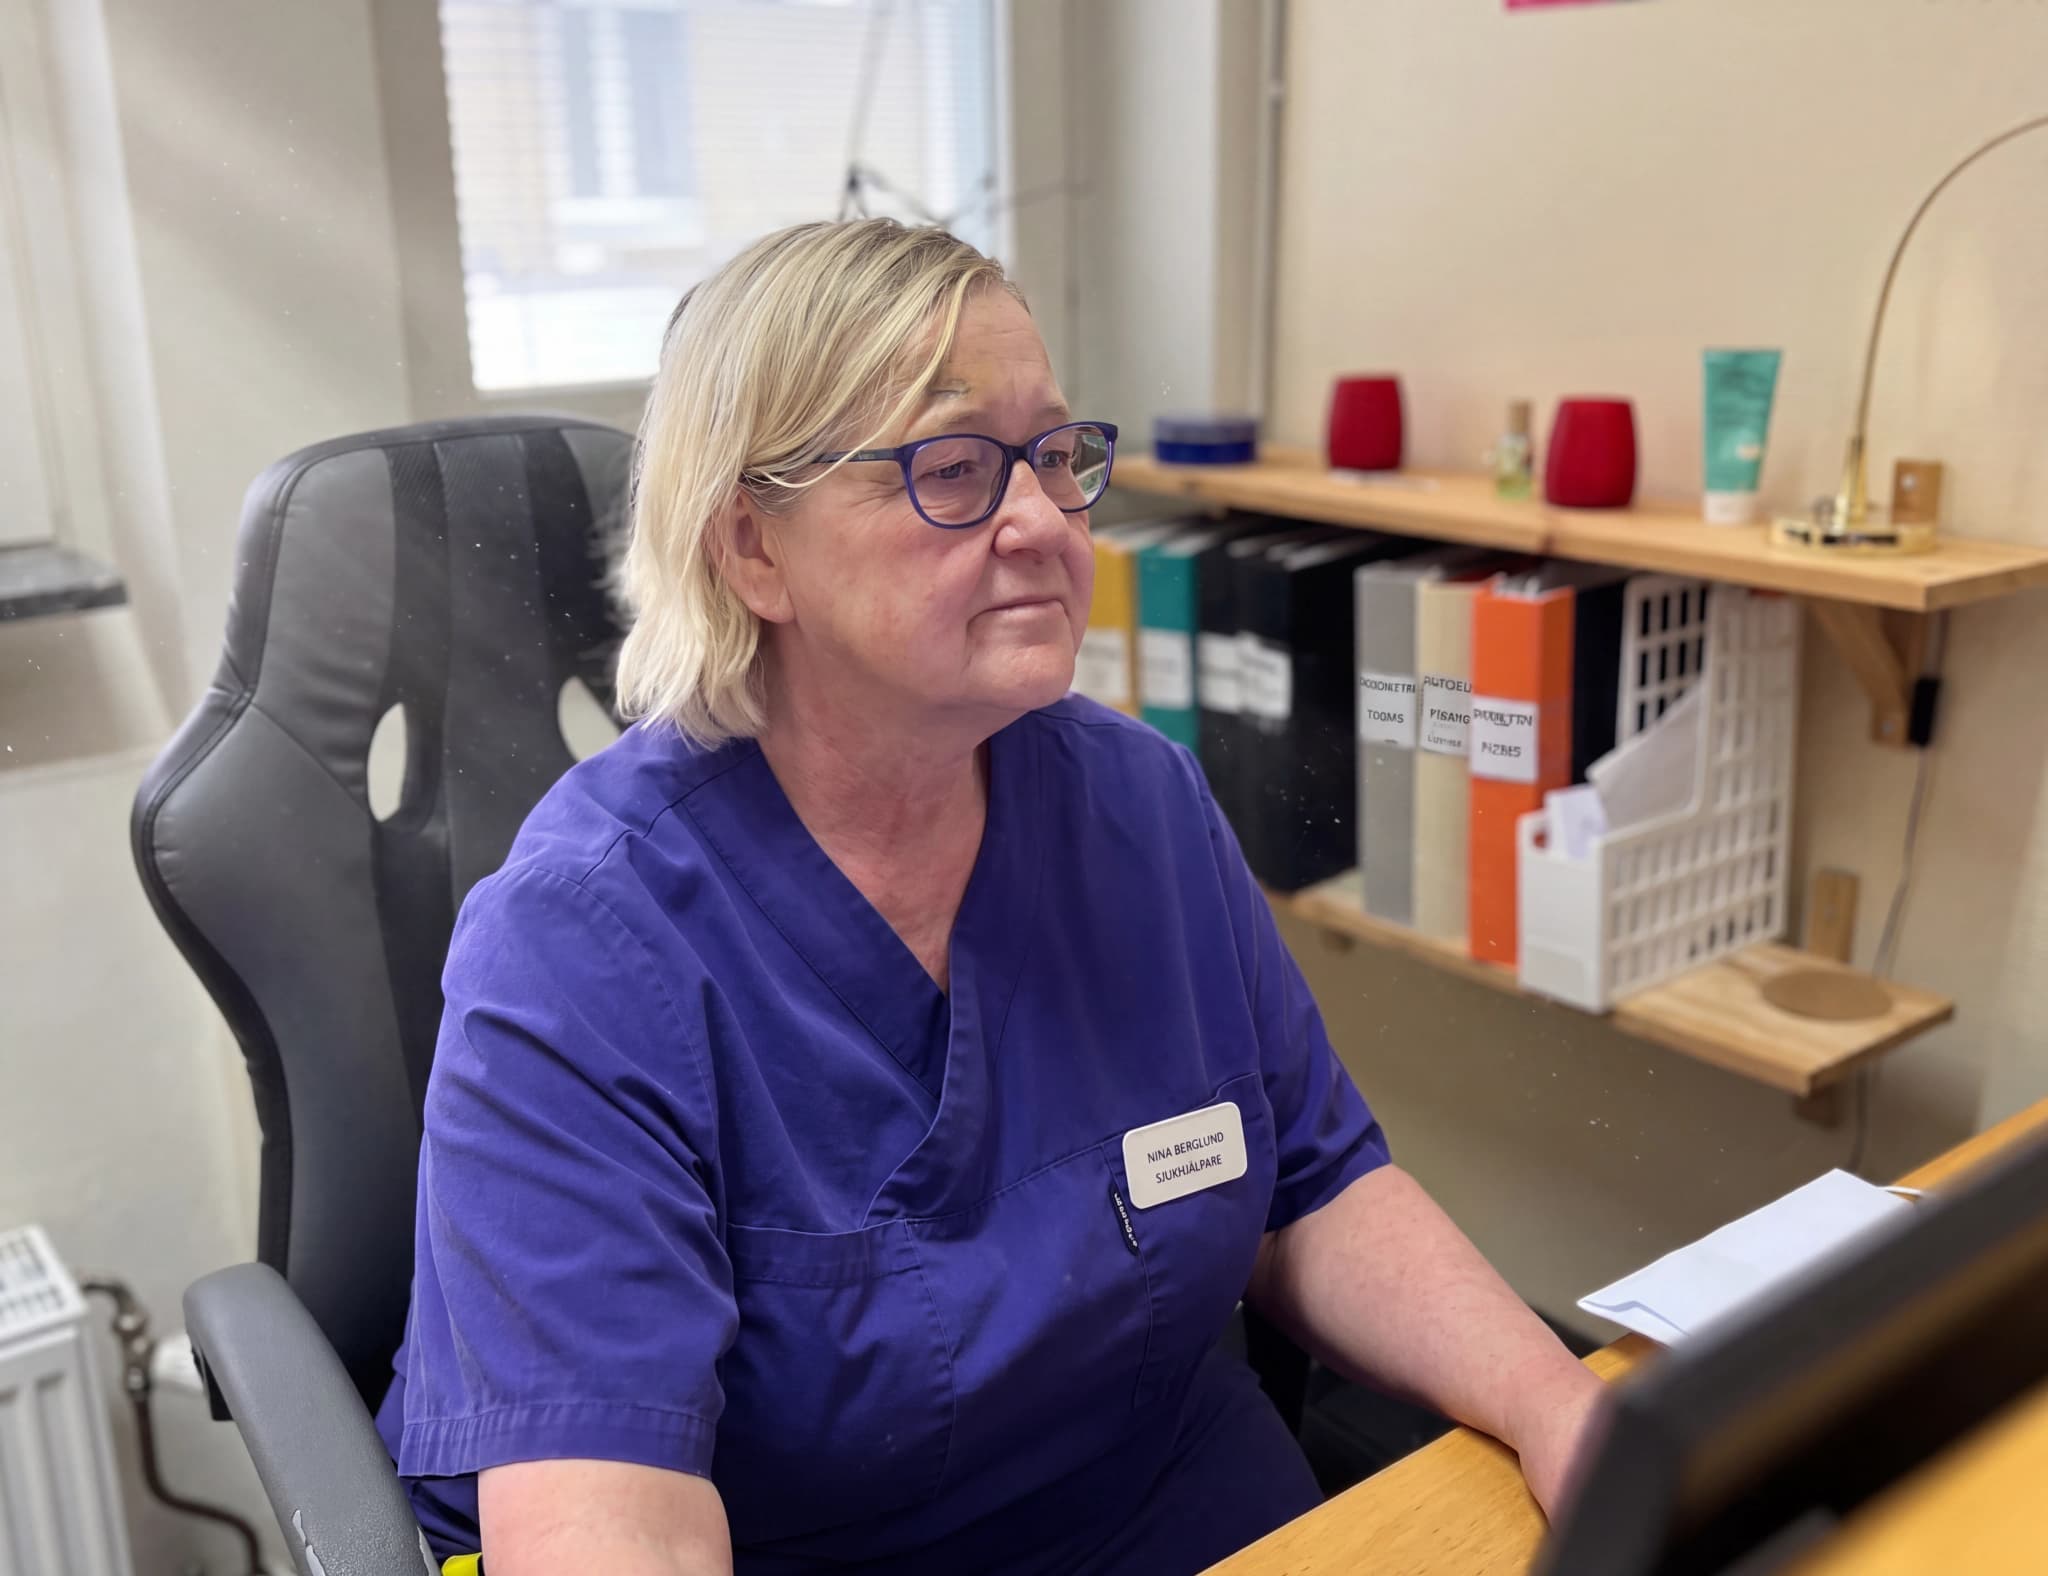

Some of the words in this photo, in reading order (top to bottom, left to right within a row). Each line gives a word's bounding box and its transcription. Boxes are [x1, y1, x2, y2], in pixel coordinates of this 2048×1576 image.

[1147, 1147, 1173, 1164] NINA
[1174, 1132, 1224, 1155] BERGLUND
[1155, 1154, 1222, 1184] SJUKHJÄLPARE
